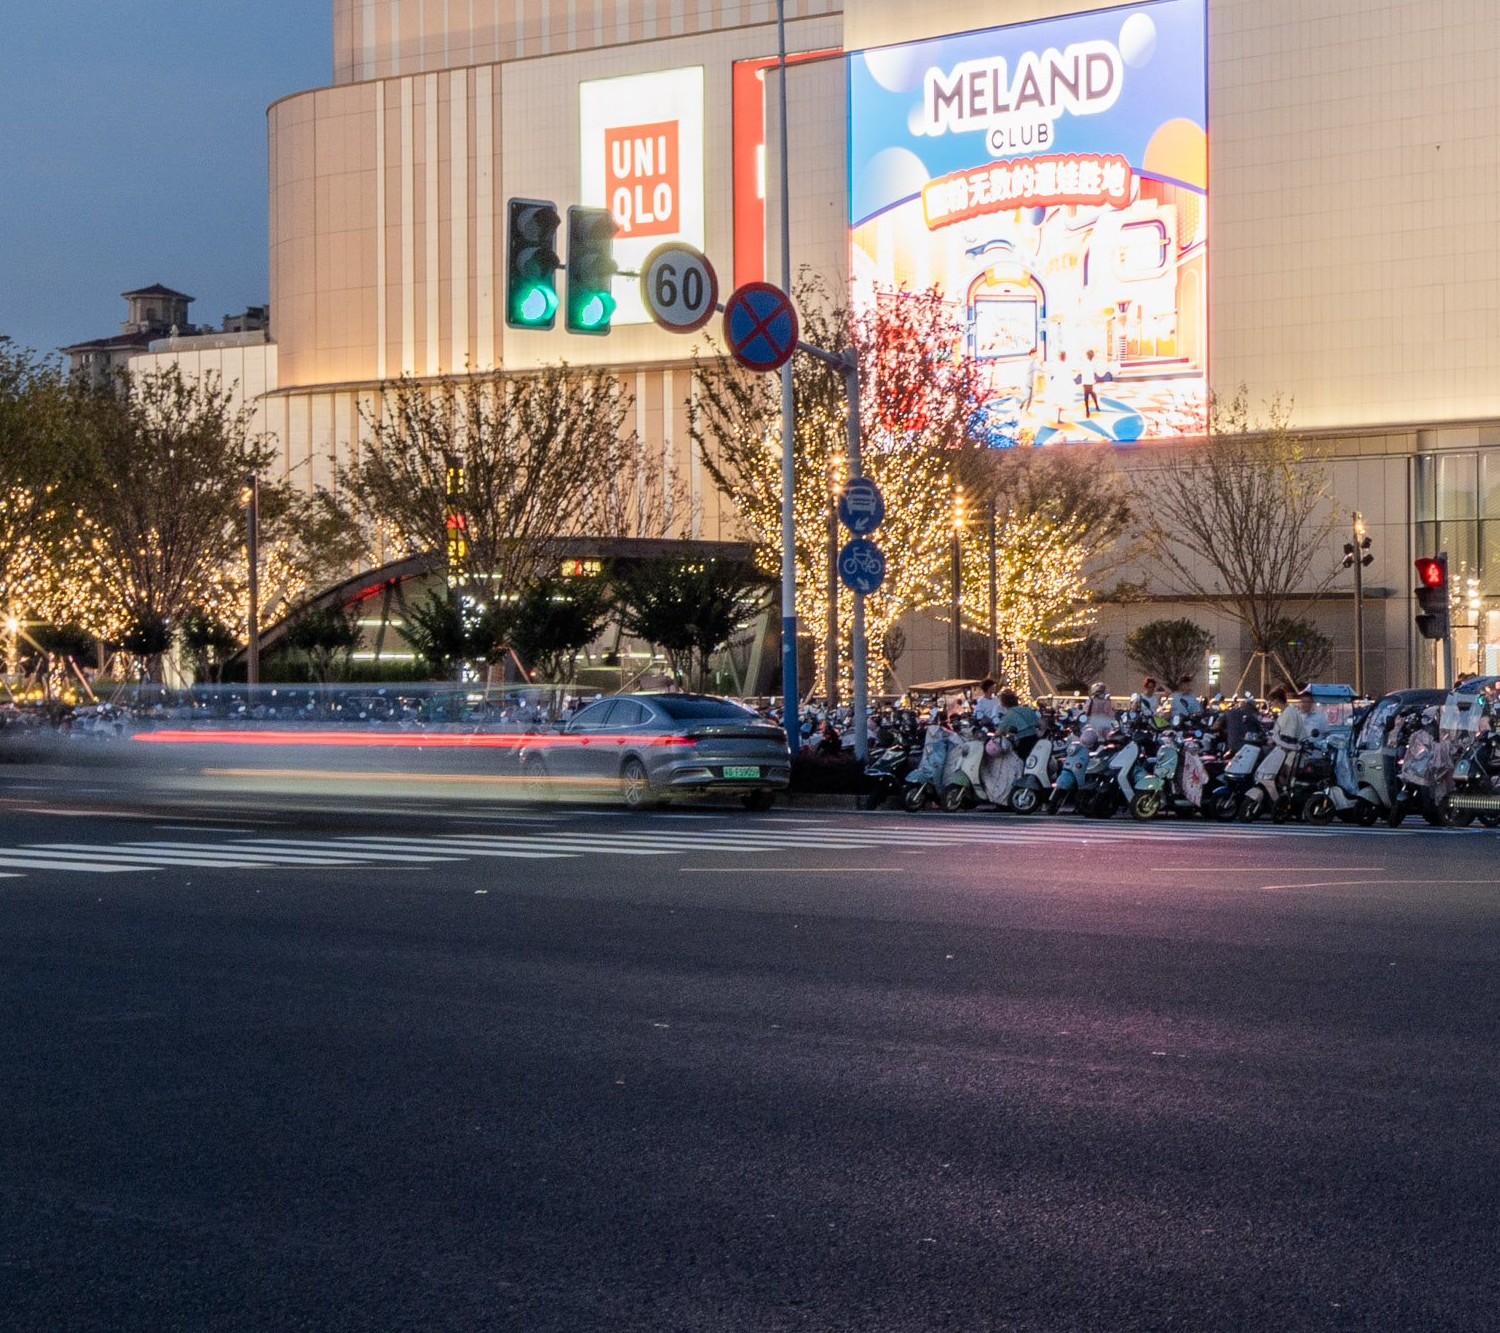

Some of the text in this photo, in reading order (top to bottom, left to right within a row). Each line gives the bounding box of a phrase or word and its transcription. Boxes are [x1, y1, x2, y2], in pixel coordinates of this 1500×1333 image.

[933, 52, 1115, 123] MELAND
[612, 136, 666, 179] UNI
[991, 123, 1049, 150] CLUB
[613, 183, 672, 232] QLO
[655, 263, 703, 311] 60
